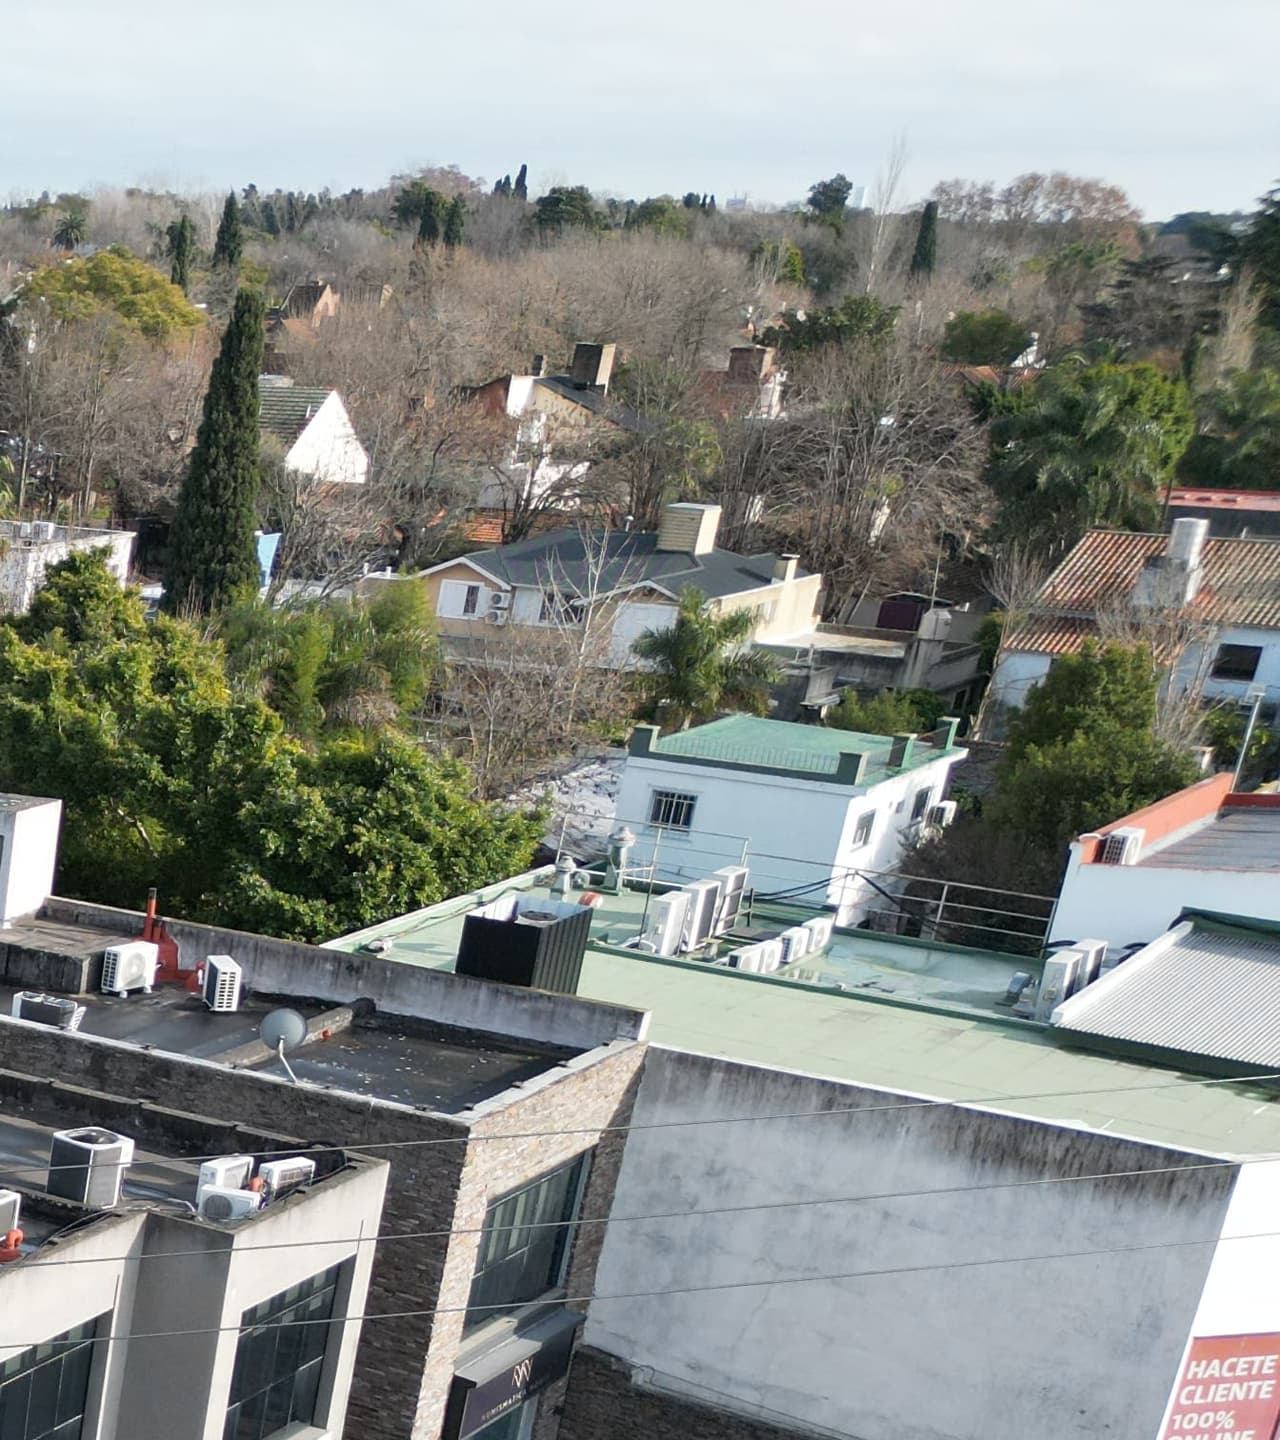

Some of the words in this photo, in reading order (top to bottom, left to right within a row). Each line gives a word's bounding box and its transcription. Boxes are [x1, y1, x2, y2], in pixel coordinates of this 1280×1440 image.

[1186, 1354, 1279, 1379] HACETE
[1179, 1380, 1276, 1405] CLIENTE
[1172, 1410, 1236, 1431] 100%
